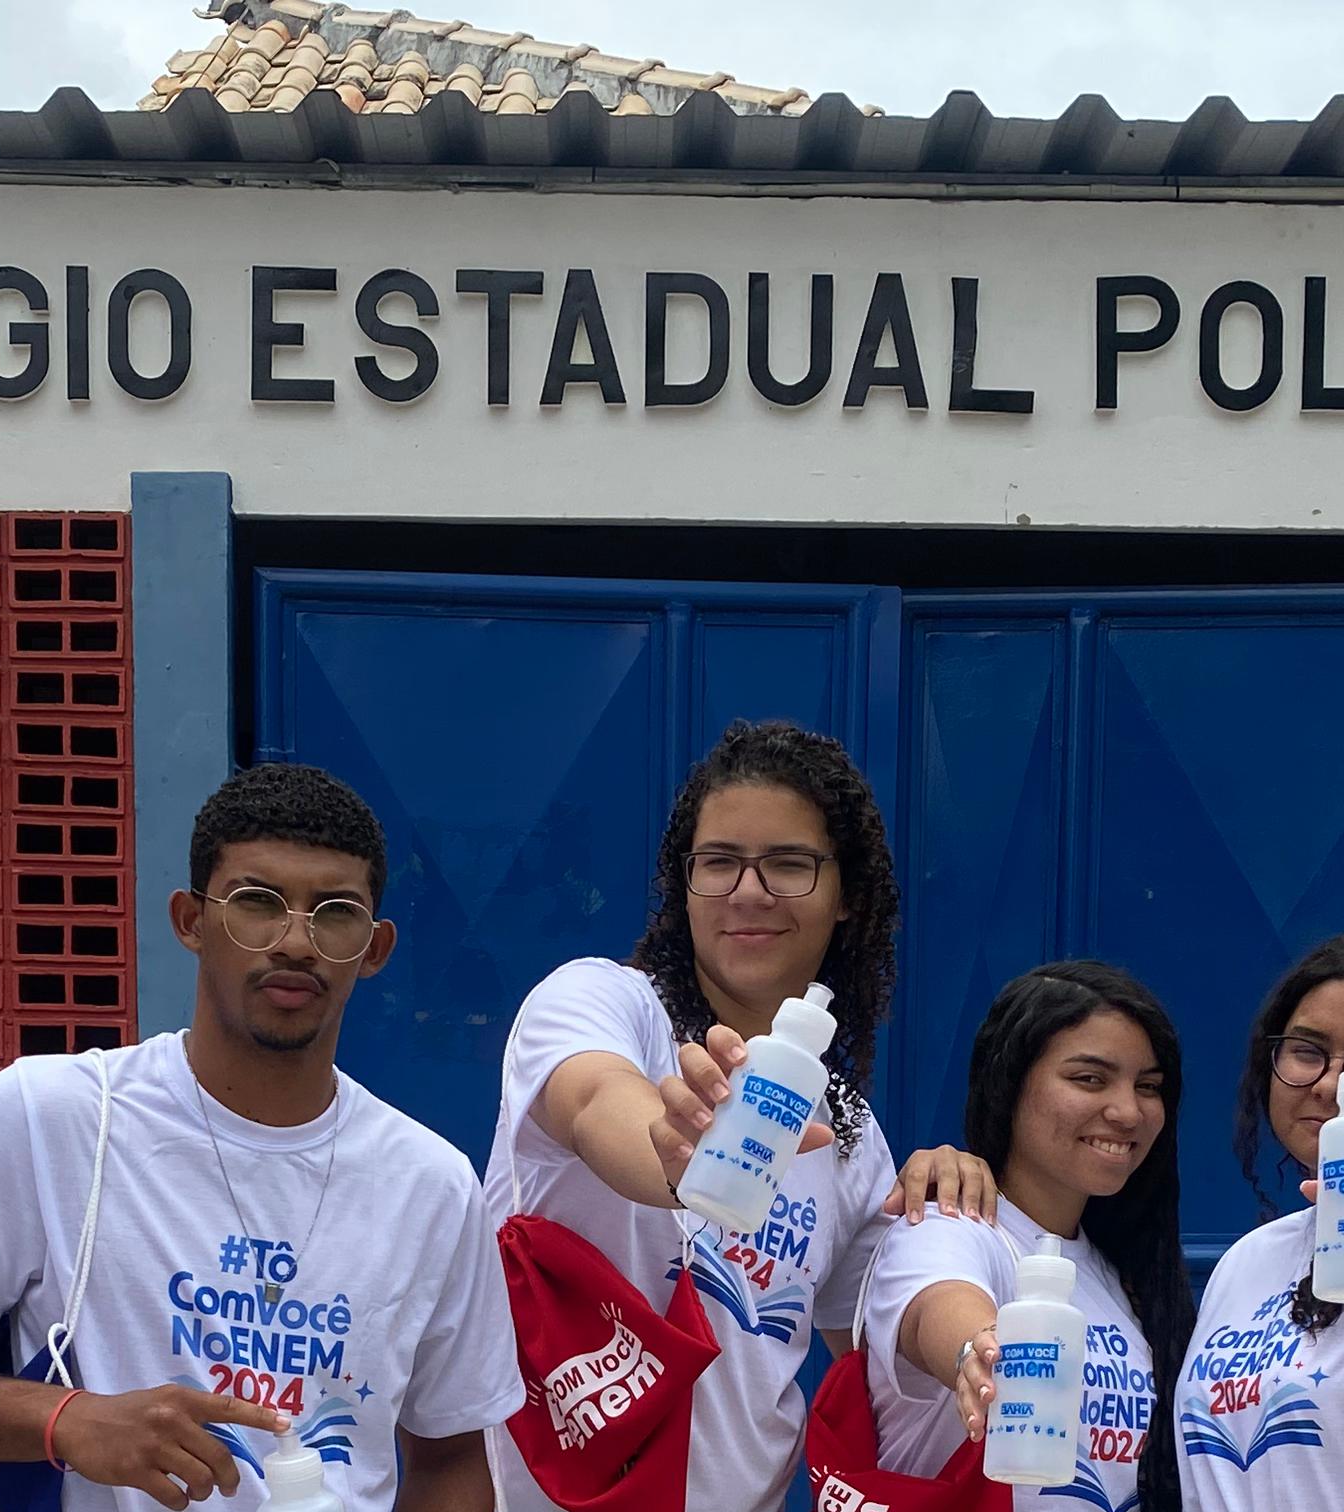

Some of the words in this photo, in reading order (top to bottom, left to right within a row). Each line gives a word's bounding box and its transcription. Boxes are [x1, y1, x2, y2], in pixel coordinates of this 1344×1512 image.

[251, 266, 1035, 413] ESTADUAL
[765, 1086, 787, 1103] COM
[758, 1100, 803, 1136] enem
[768, 1193, 817, 1233] ocê
[219, 1235, 298, 1283] #Tô
[168, 1271, 352, 1335] ComVocê
[1251, 1281, 1297, 1321] #T
[171, 1315, 345, 1380] NoENEM
[585, 1326, 635, 1380] VOCÊ
[1028, 1347, 1056, 1359] VOCÊ
[1086, 1324, 1129, 1357] #Tô
[1187, 1337, 1302, 1383] NoENEM
[1004, 1360, 1055, 1378] enem
[1082, 1359, 1156, 1393] omVoc
[209, 1364, 305, 1416] 2024
[1210, 1373, 1262, 1415] 2024
[1079, 1391, 1156, 1430] NoENE
